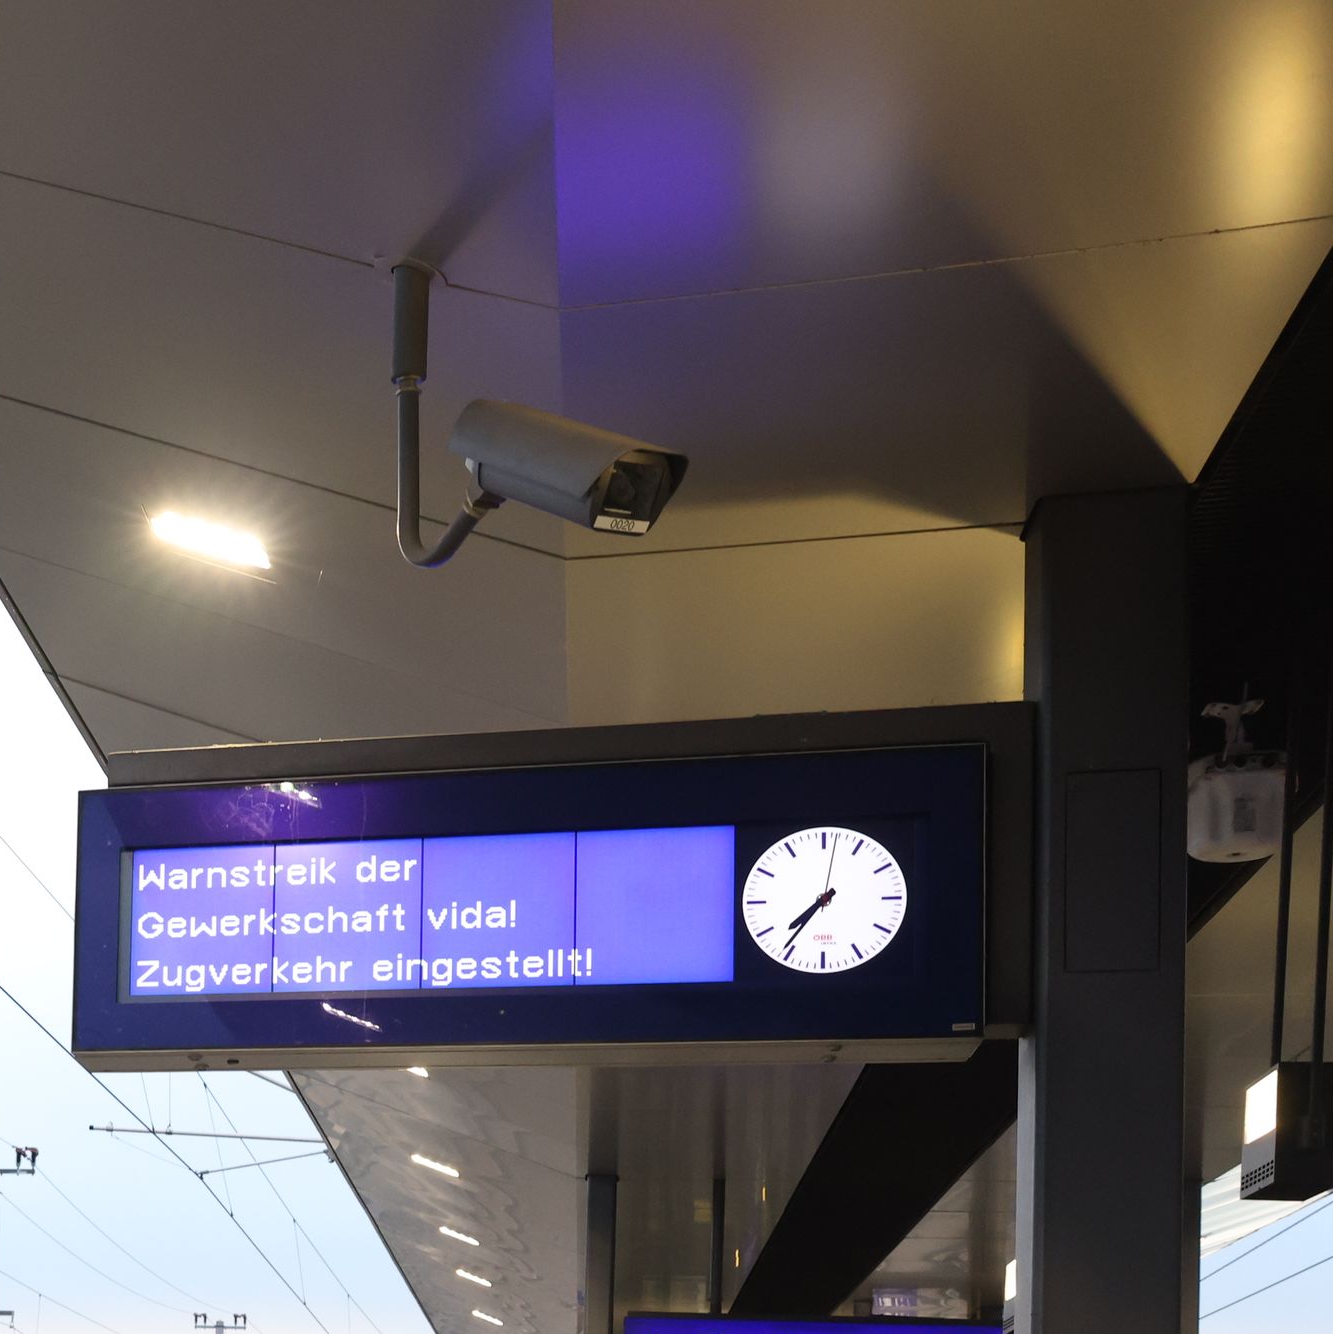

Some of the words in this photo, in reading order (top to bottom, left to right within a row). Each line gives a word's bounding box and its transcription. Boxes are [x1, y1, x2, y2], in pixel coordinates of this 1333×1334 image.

[611, 519, 635, 531] 0020
[138, 857, 336, 891] Warnstreik
[356, 855, 417, 884] der
[137, 903, 406, 940] Gewerkschaft
[427, 899, 517, 931] vida!
[136, 955, 353, 992] Zugverkehr
[372, 947, 594, 986] eingestellt!
